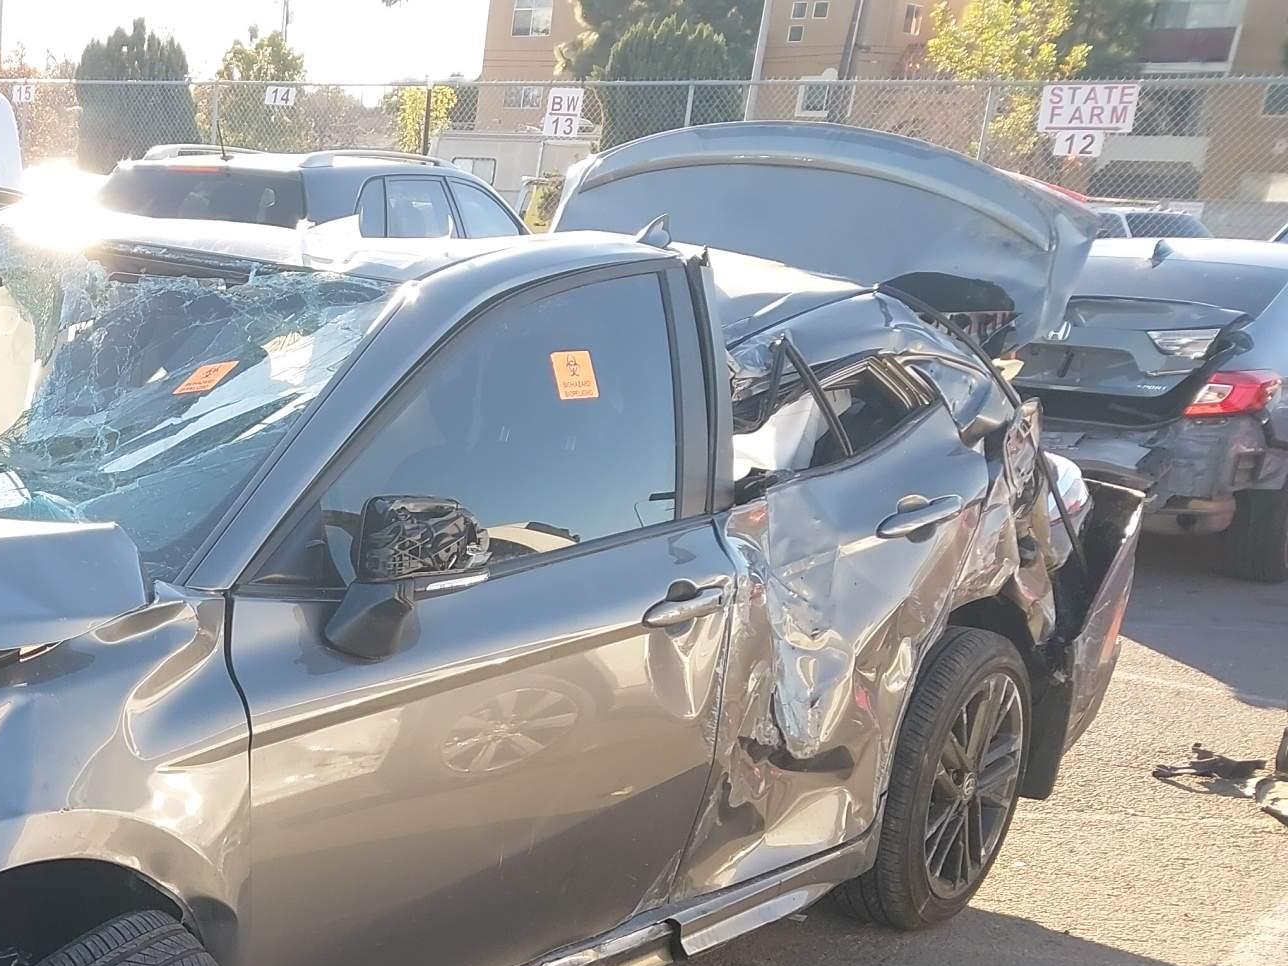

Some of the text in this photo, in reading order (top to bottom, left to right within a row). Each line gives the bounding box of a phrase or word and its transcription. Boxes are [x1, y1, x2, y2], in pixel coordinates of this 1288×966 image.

[17, 86, 31, 101] 15
[272, 88, 290, 104] 14
[1049, 86, 1135, 105] STATE
[551, 95, 579, 112] BW
[1049, 105, 1128, 124] FARM
[552, 117, 573, 135] 13
[1065, 133, 1095, 154] 12
